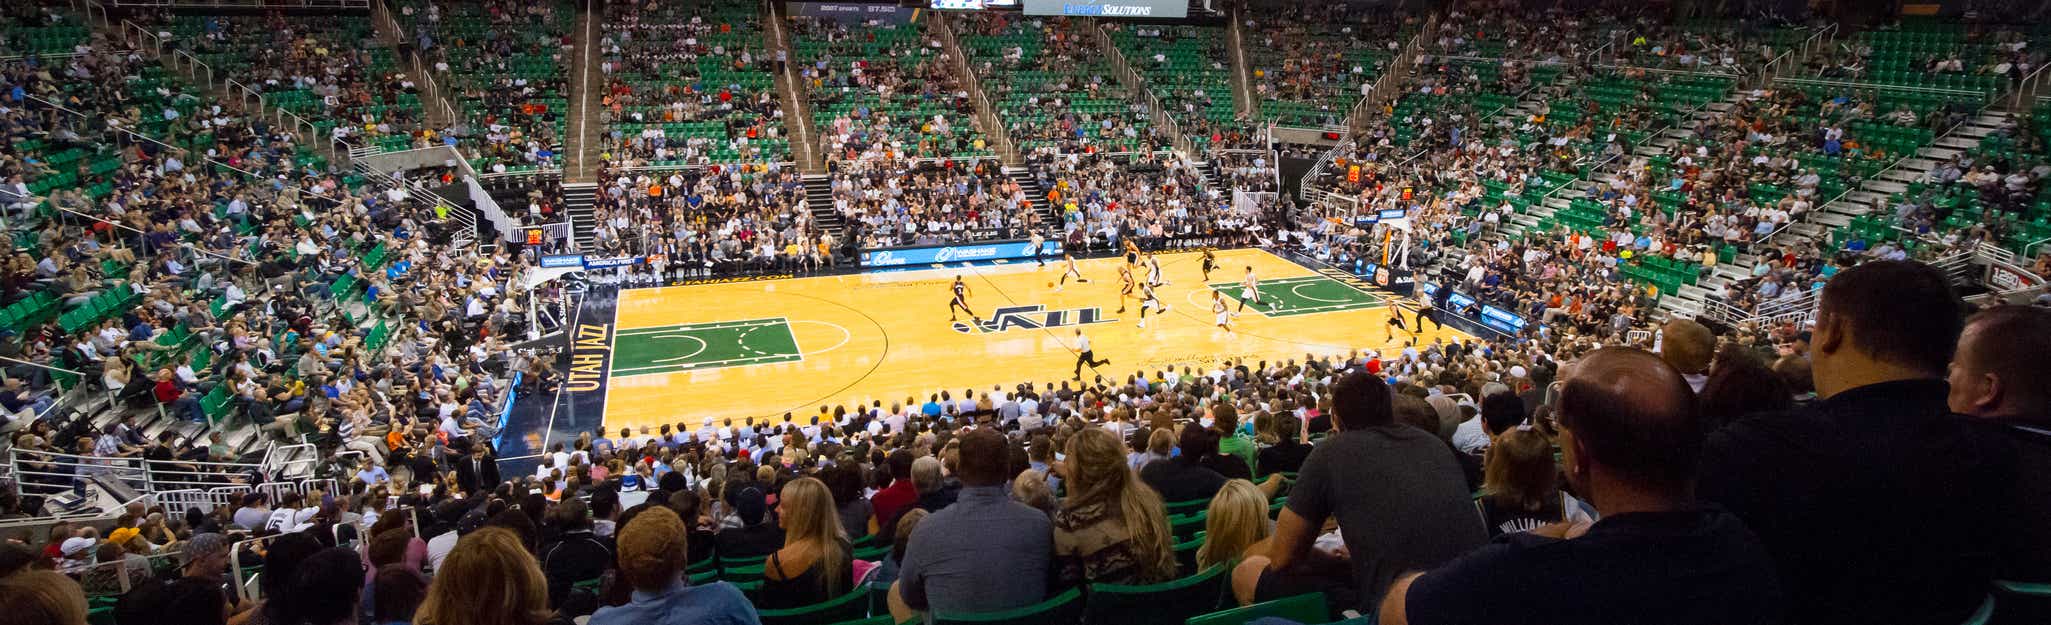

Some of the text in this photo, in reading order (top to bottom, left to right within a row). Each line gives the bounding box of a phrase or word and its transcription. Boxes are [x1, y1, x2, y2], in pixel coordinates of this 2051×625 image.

[588, 259, 617, 267] AMERICA
[566, 323, 611, 392] UTAH JAZZ
[1499, 517, 1553, 534] WILLIAM
